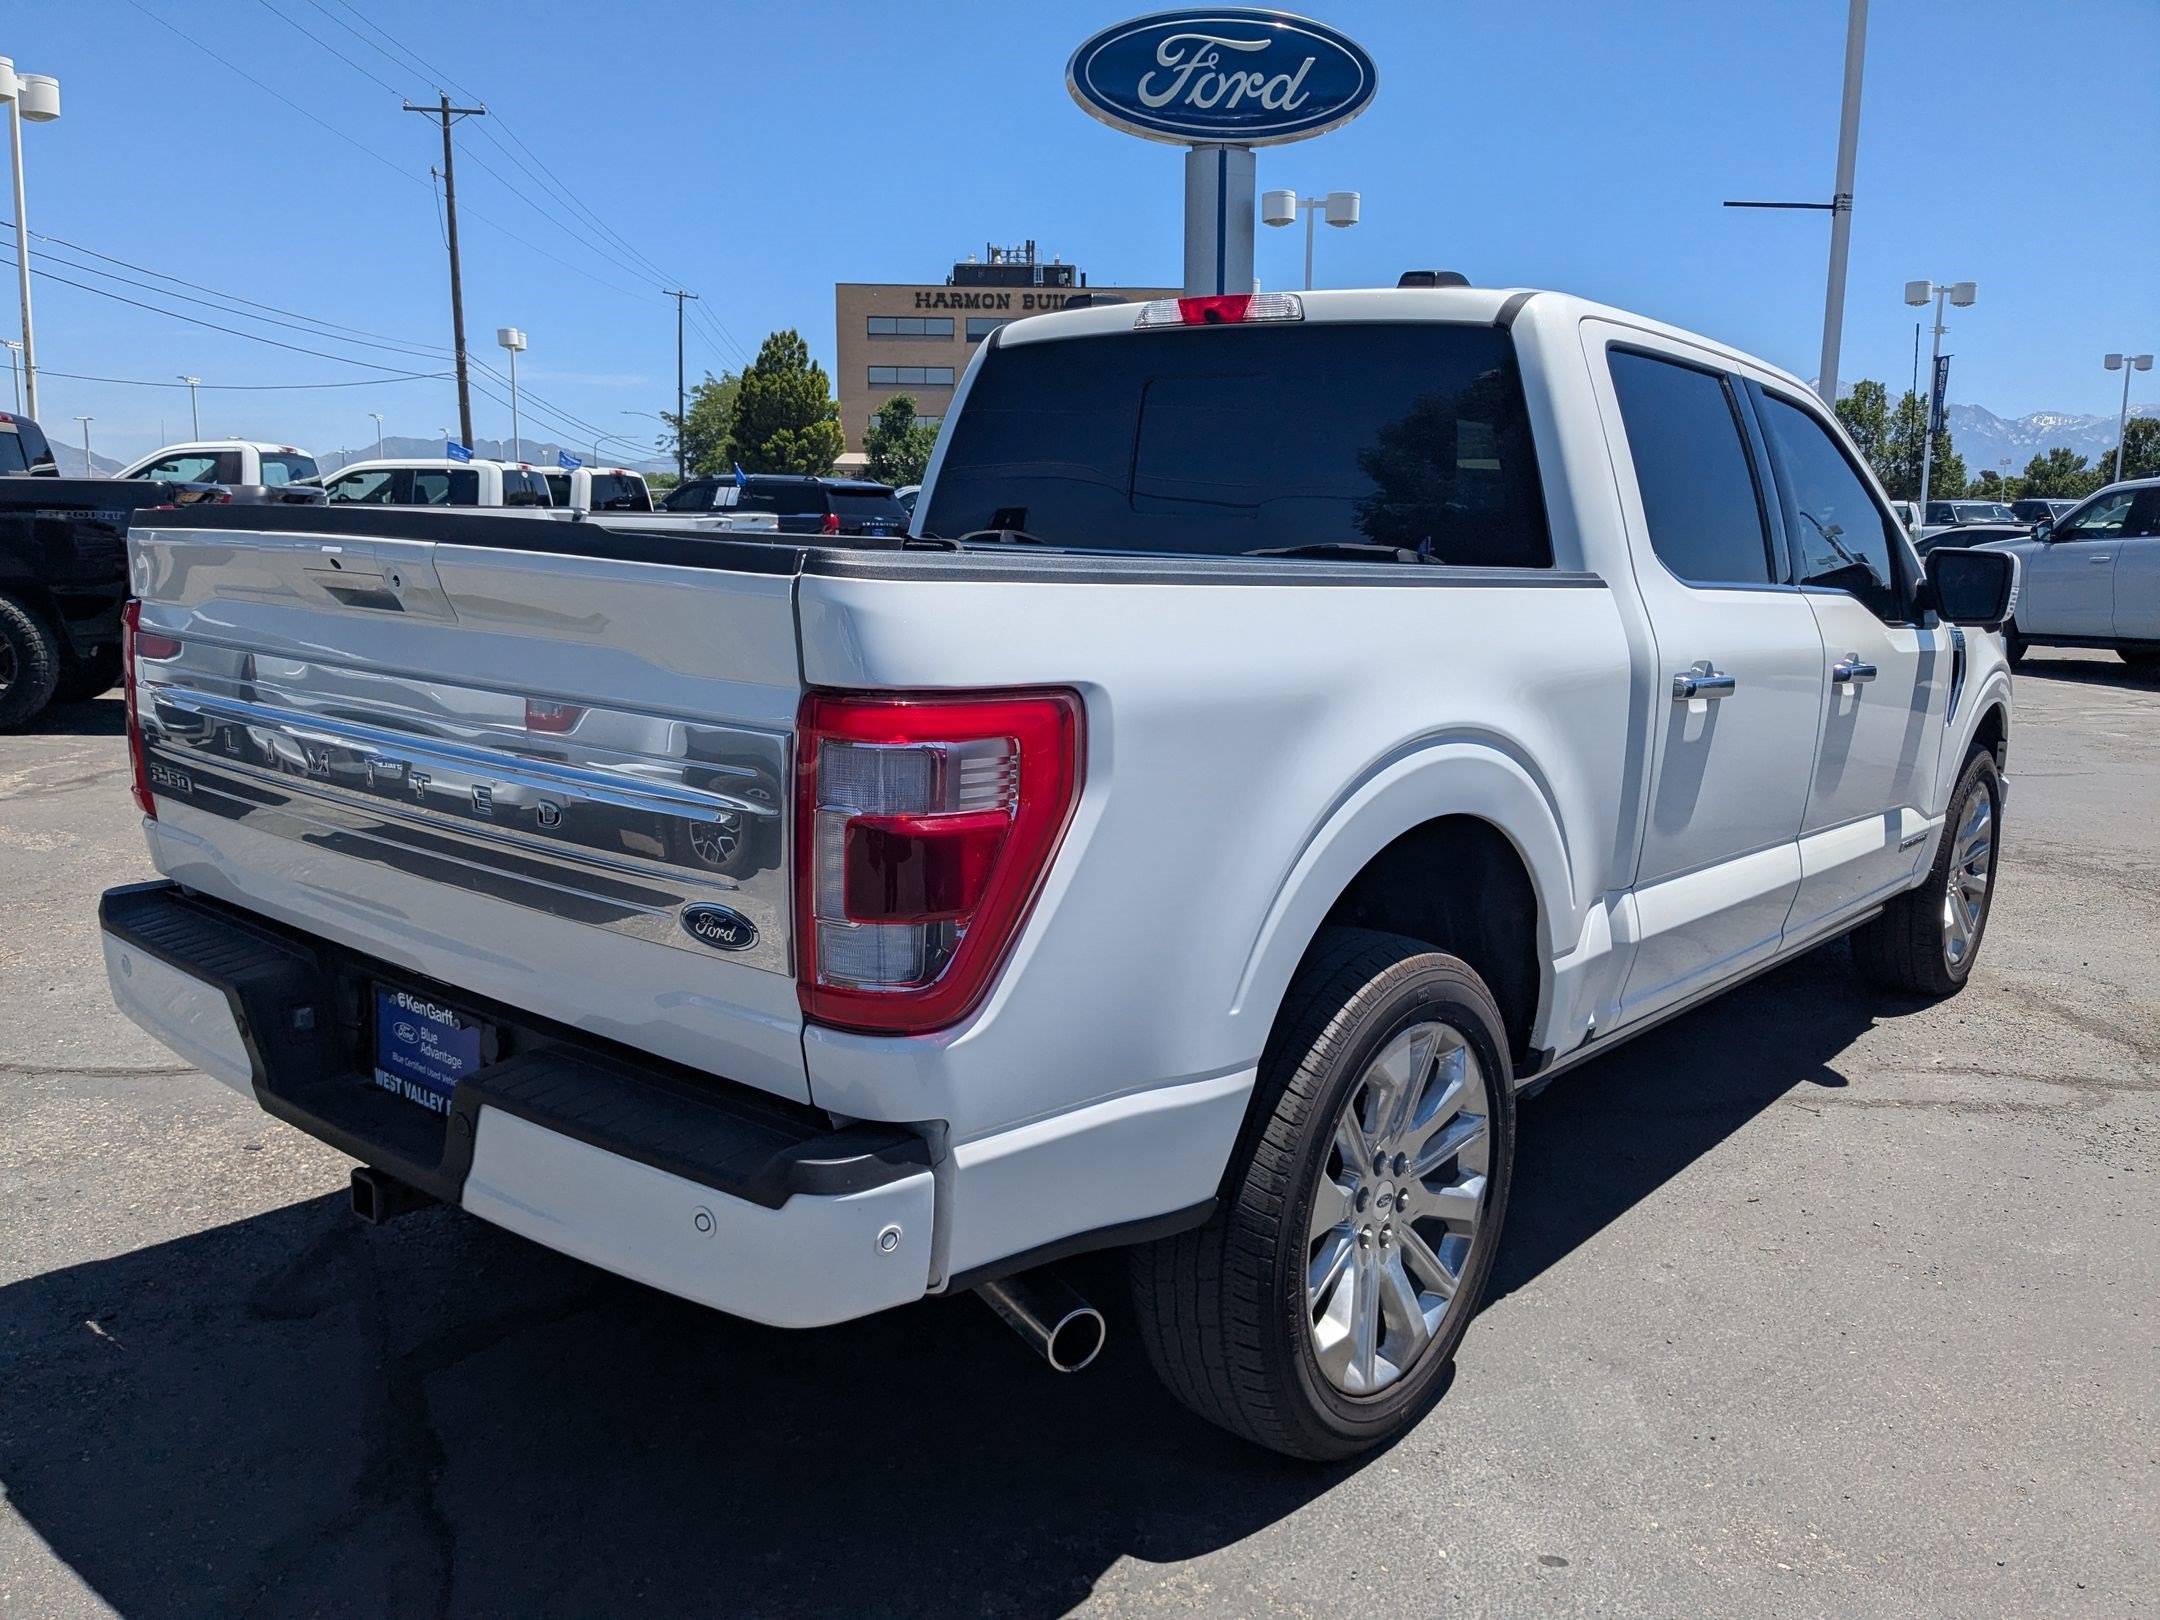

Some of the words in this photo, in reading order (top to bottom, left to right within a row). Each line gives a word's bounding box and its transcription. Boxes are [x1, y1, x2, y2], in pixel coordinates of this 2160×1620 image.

[1138, 33, 1316, 111] Ford
[915, 292, 1011, 309] HARMON
[223, 727, 563, 829] LIMITED
[695, 912, 737, 942] Ford
[398, 1025, 415, 1041] Ford
[421, 1027, 438, 1044] Blue
[392, 1051, 404, 1064] Blue
[404, 1057, 426, 1073] Certified
[426, 1066, 441, 1080] Used
[421, 1042, 463, 1069] Advantage
[374, 1067, 402, 1094] WEST
[404, 1081, 444, 1112] VALLEY
